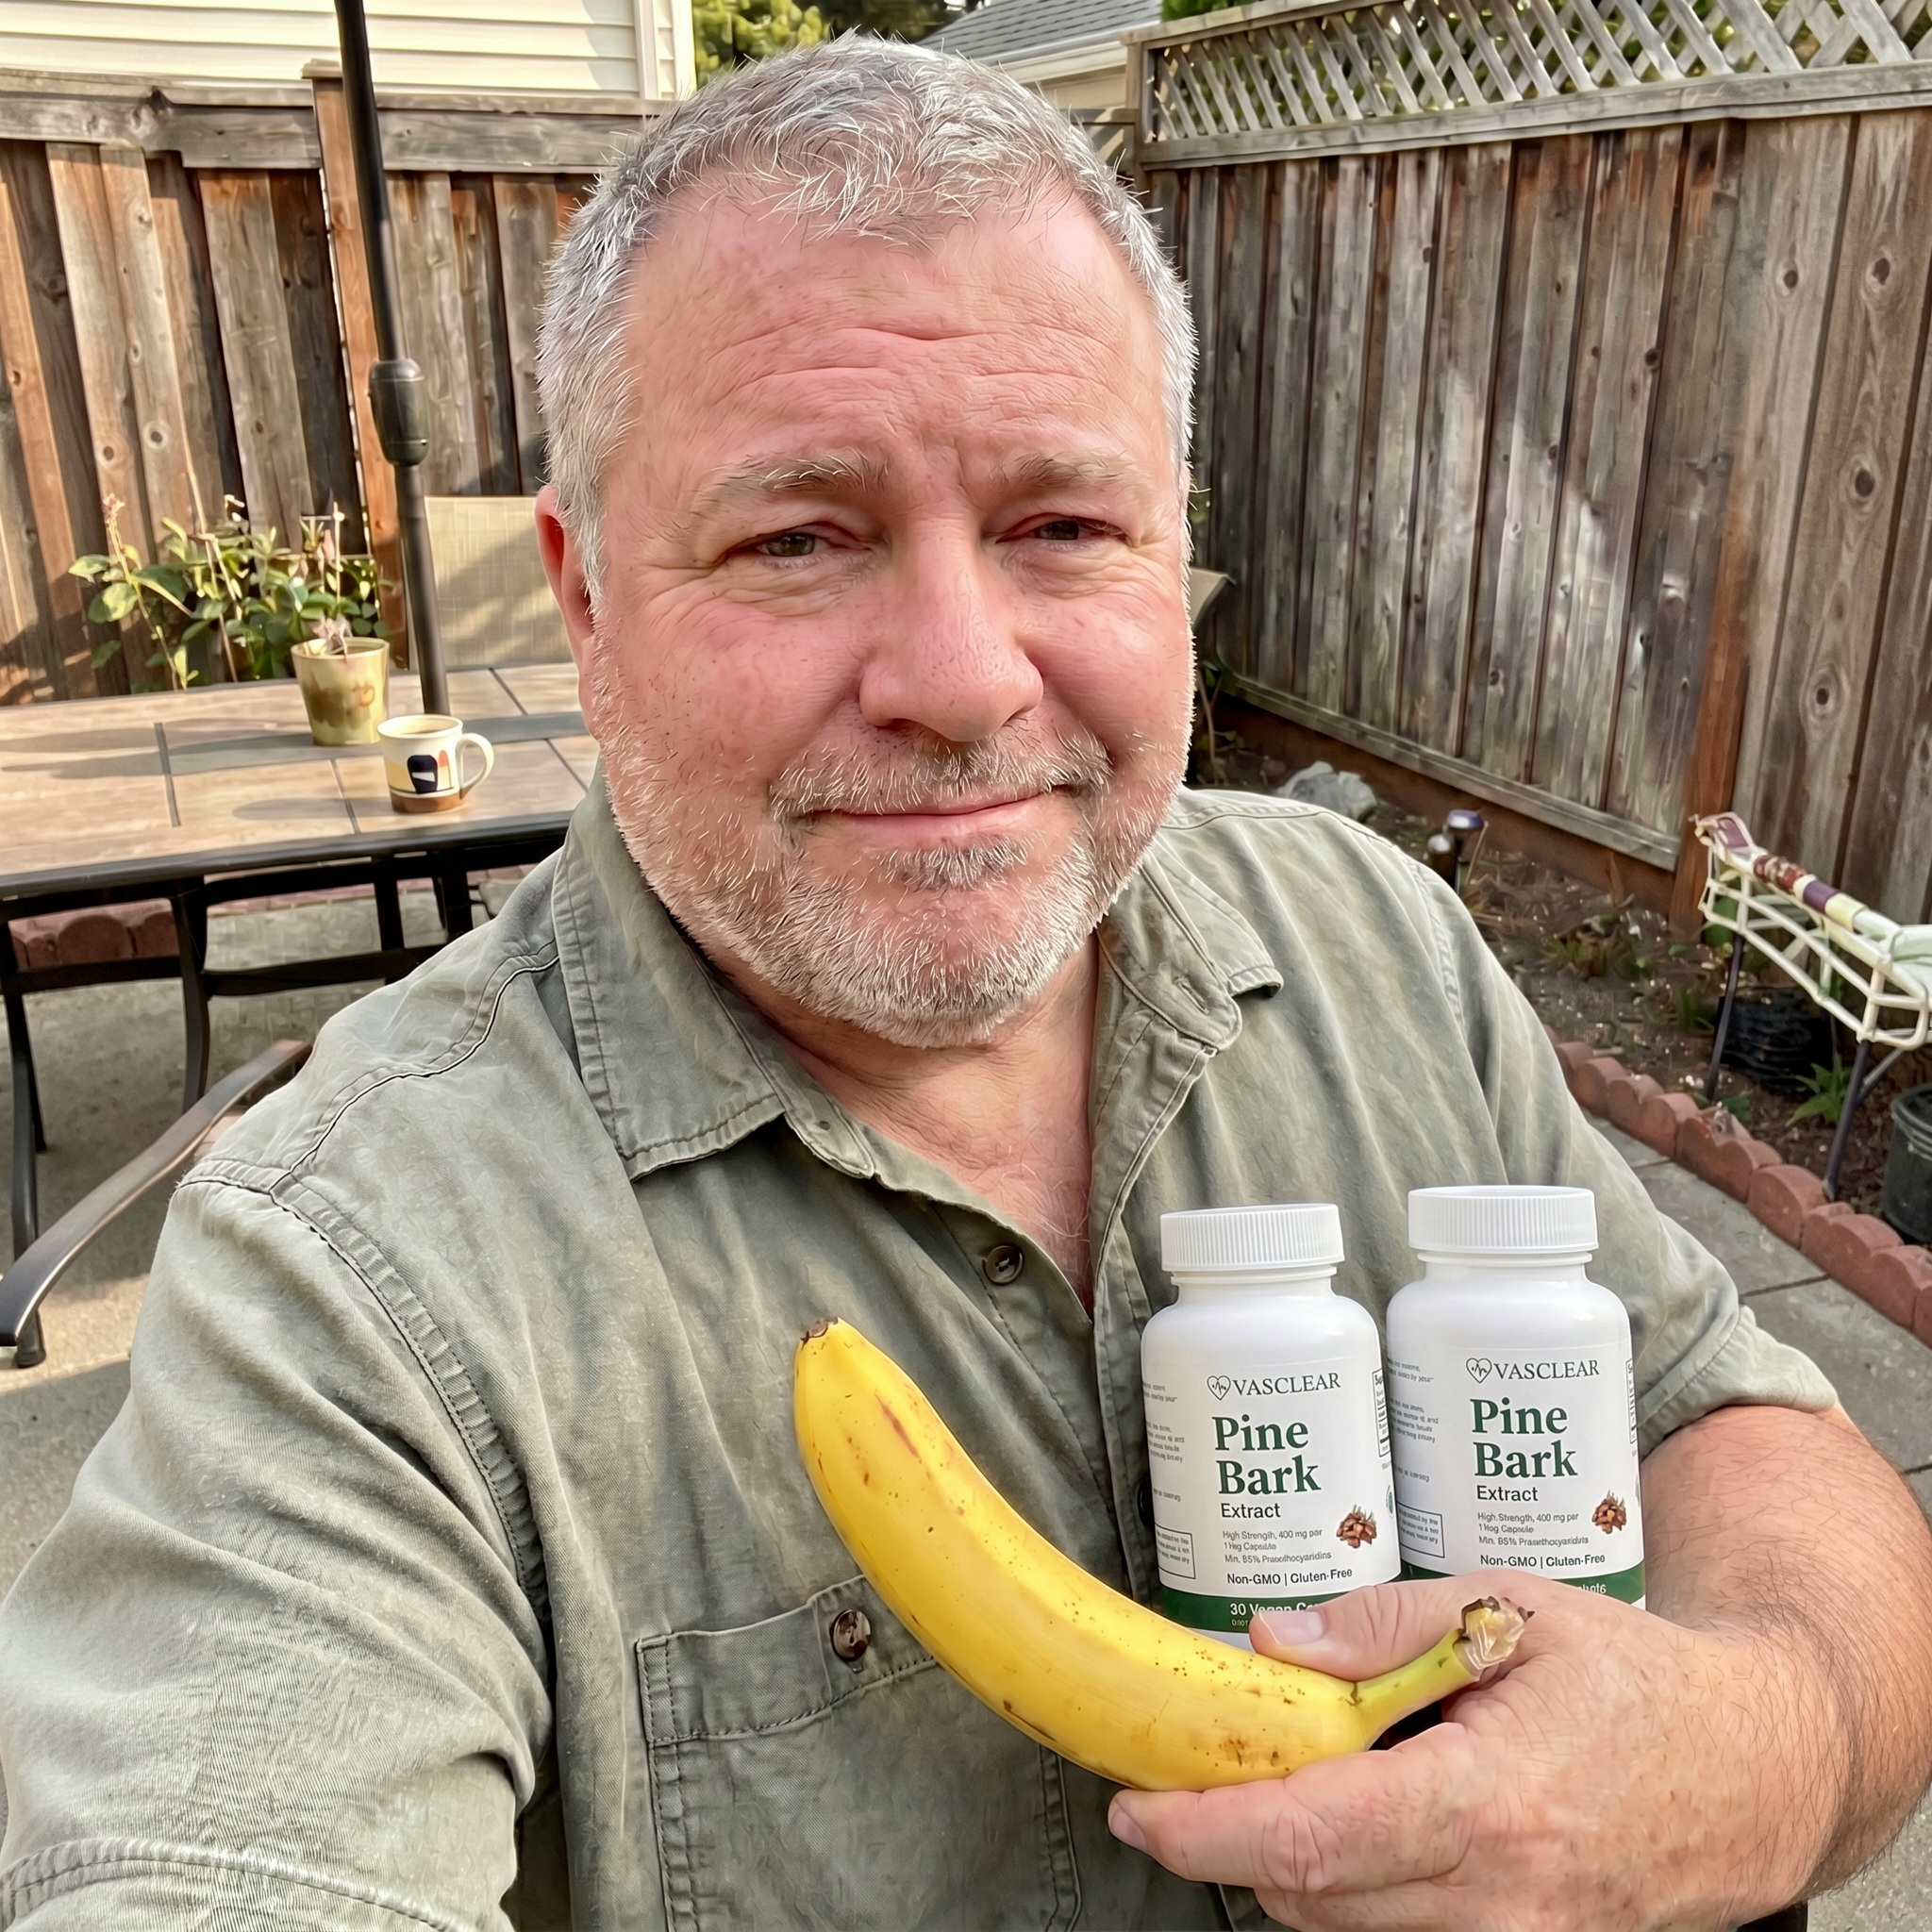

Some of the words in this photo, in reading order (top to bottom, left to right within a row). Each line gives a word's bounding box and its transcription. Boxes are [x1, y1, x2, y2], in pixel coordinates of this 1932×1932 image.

[1493, 1359, 1600, 1380] VASCLEAR
[1232, 1372, 1341, 1396] VASCLEAR
[1470, 1396, 1568, 1435] Pine
[1211, 1413, 1309, 1452] Pine
[1473, 1440, 1578, 1478] Bark
[1216, 1454, 1322, 1495] Bark
[1476, 1485, 1539, 1503] Extract
[1221, 1502, 1281, 1519] Extract
[1536, 1513, 1552, 1523] 400
[1553, 1513, 1566, 1524] mg
[1278, 1529, 1294, 1540] 400
[1295, 1530, 1308, 1540] mg
[1480, 1554, 1538, 1568] Non-GMO
[1226, 1573, 1281, 1585] Non-GMO
[1230, 1603, 1246, 1616] 30
